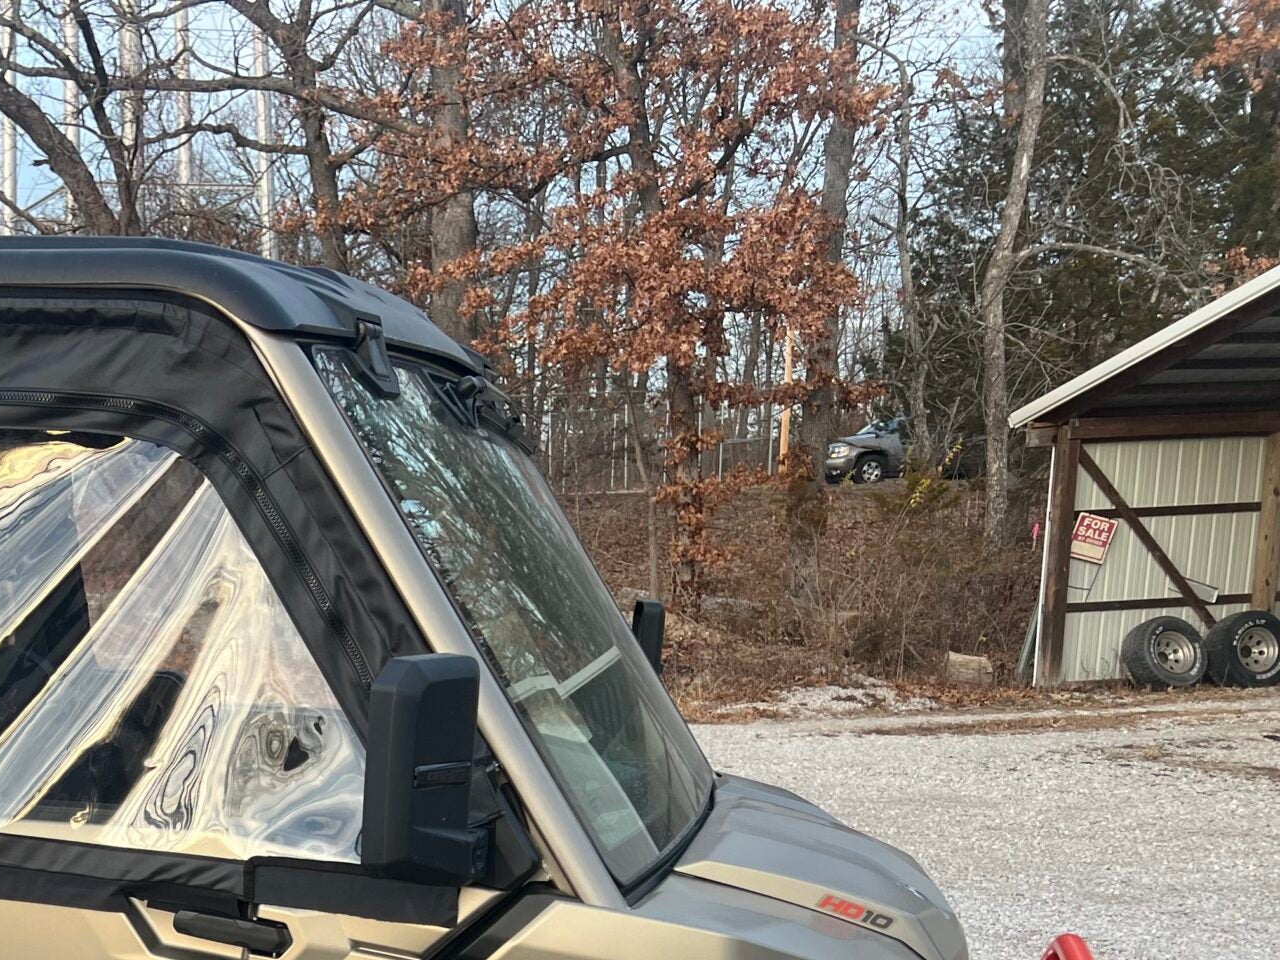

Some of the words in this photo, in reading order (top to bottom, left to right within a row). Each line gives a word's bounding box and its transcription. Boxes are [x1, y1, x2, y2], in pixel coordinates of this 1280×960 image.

[1083, 517, 1110, 532] FOR
[1077, 526, 1110, 542] SALE
[818, 894, 894, 929] HD10
